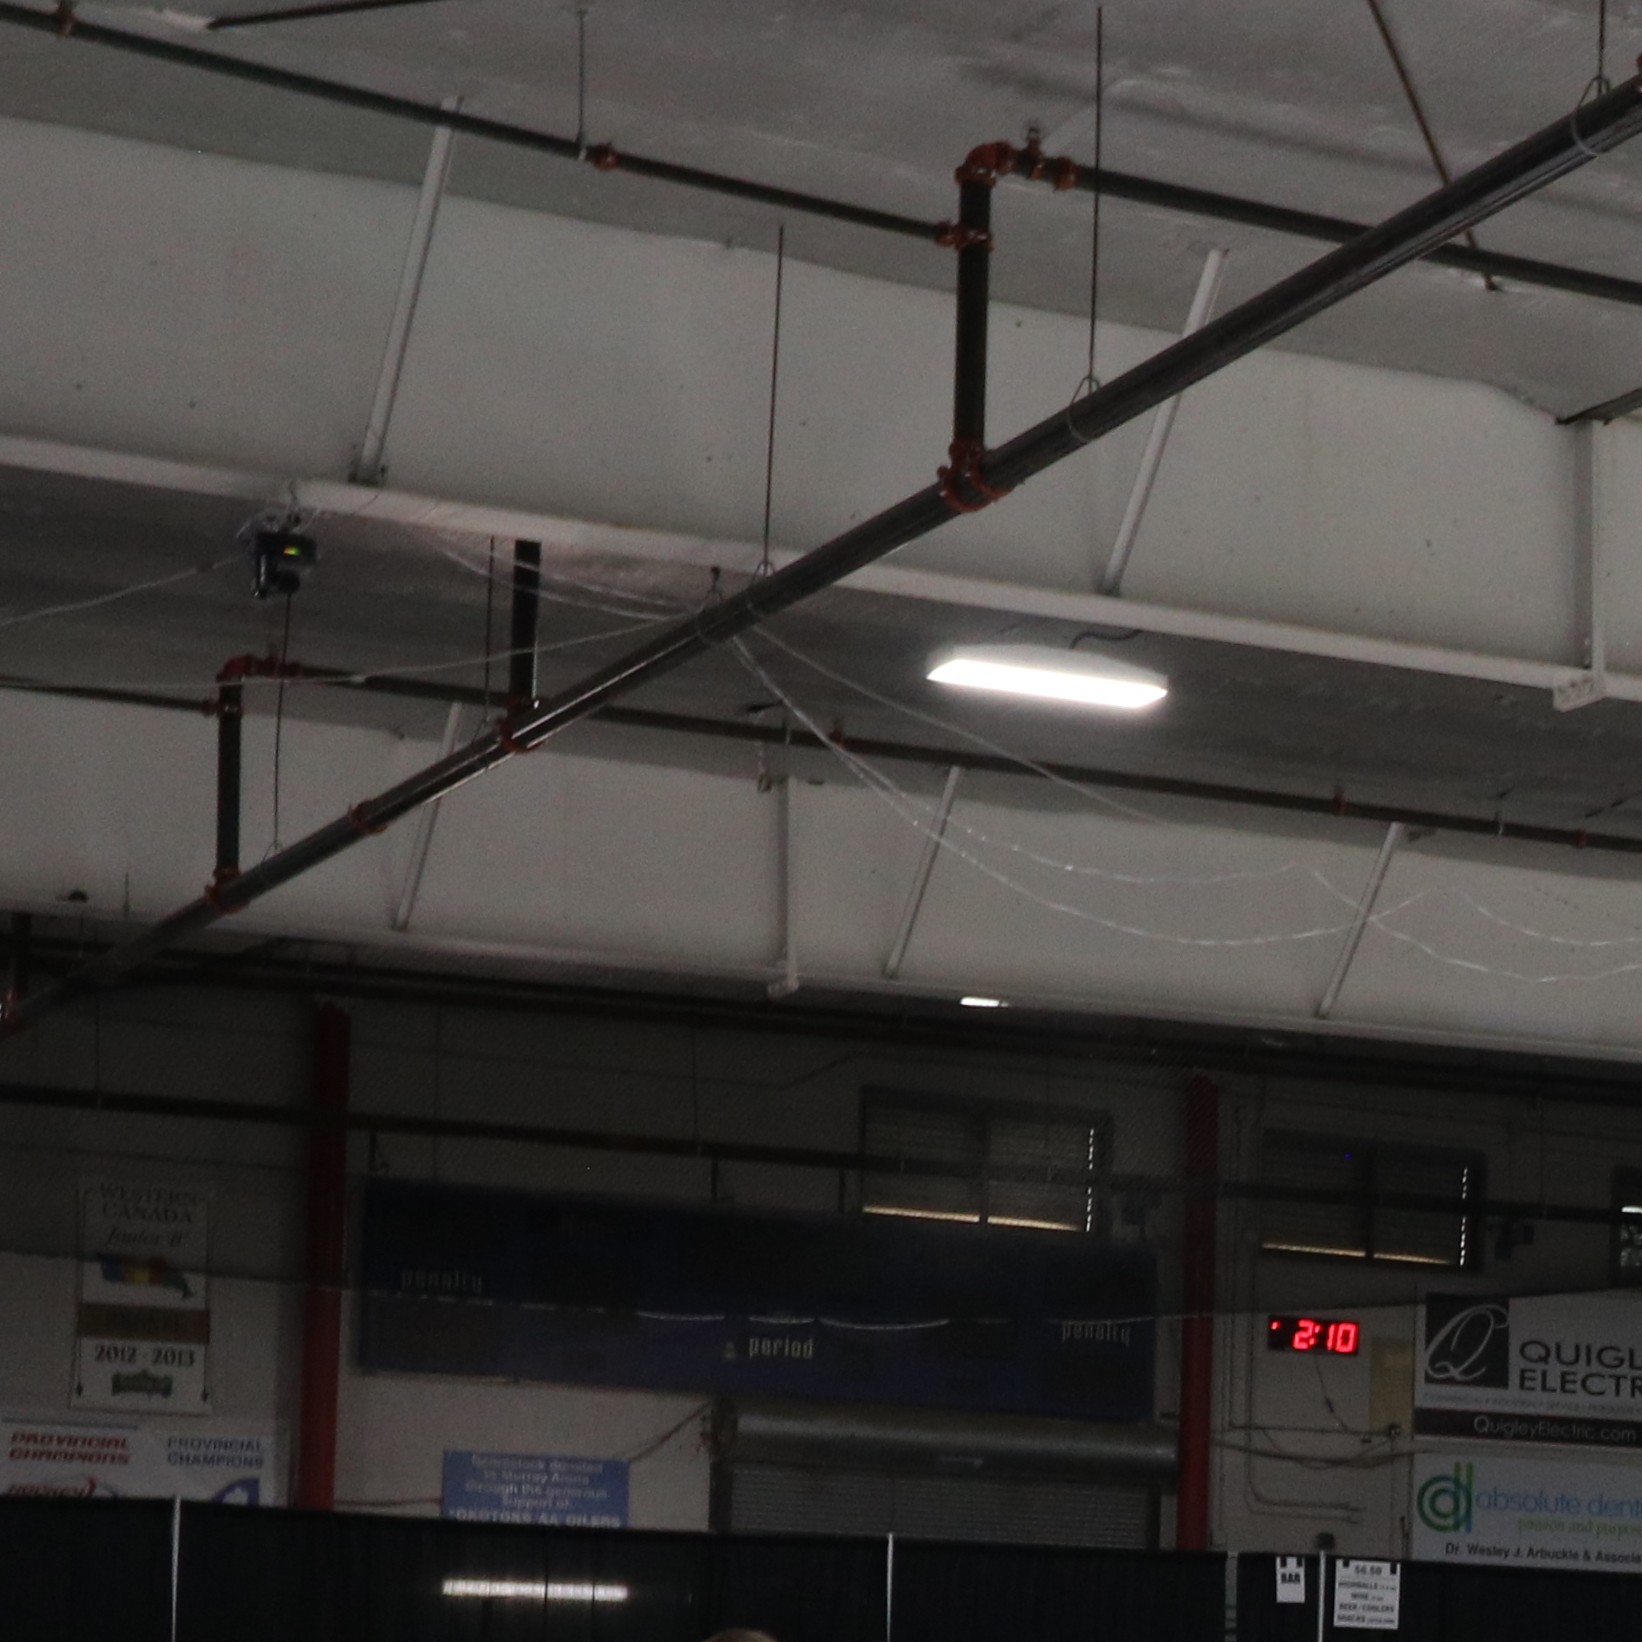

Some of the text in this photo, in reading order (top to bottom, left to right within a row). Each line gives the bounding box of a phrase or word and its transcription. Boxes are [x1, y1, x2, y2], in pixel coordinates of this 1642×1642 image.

[101, 1205, 193, 1224] CANADA
[400, 1271, 483, 1294] penalty
[1291, 1318, 1360, 1354] 2:10
[95, 1343, 195, 1367] 2012 2013
[747, 1335, 815, 1361] period
[1473, 1415, 1638, 1444] QuigleyElectric.com
[11, 1432, 129, 1450] PROVINCIAL
[167, 1436, 261, 1451] PROVINCIAL
[9, 1450, 132, 1466] CHAMPIONS
[167, 1454, 264, 1470] CHAMPIONS
[1476, 1486, 1583, 1515] absolute
[1445, 1541, 1462, 1555] Dr.
[1467, 1543, 1510, 1559] Wesley
[1527, 1546, 1581, 1561] Arbuckle
[1281, 1572, 1302, 1584] BAR
